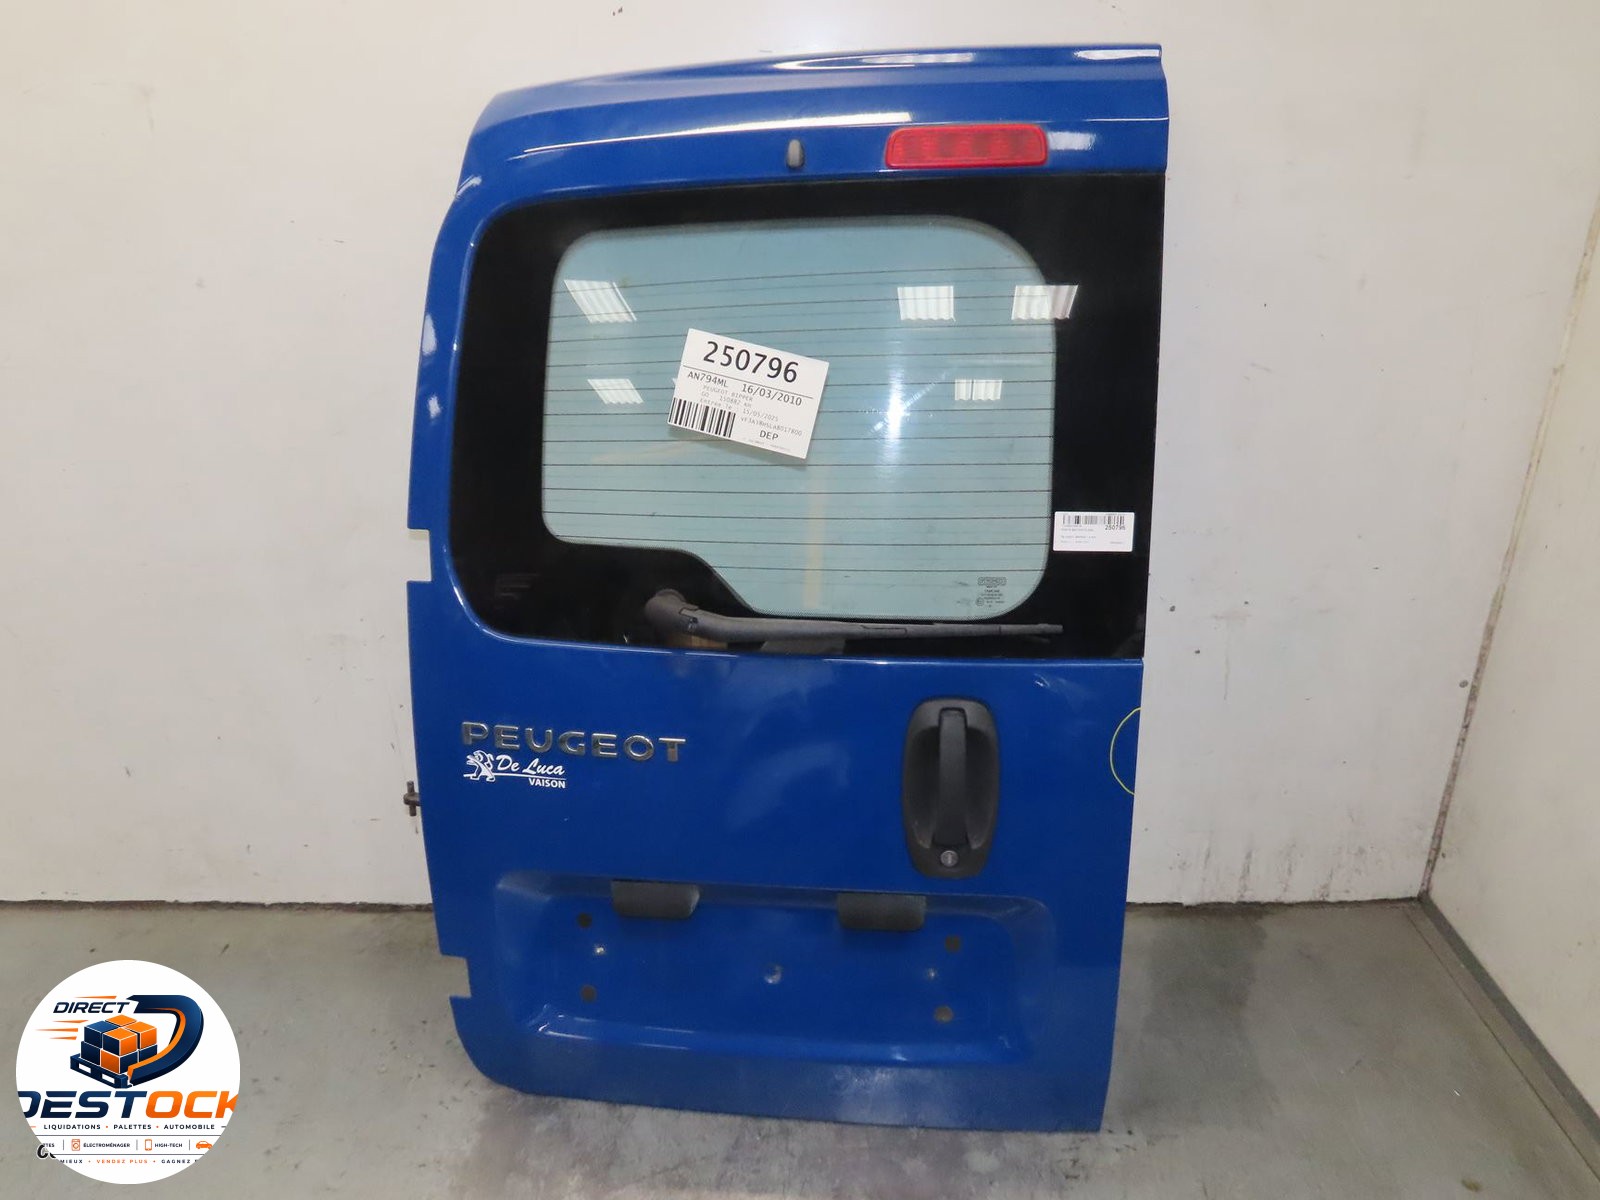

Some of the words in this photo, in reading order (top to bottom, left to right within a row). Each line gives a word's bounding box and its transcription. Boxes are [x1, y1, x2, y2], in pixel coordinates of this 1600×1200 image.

[703, 341, 799, 383] 250796
[687, 371, 728, 387] AN794ML
[742, 383, 802, 407] 16/03/2010
[759, 430, 779, 440] DEP
[461, 721, 687, 762] PEUGEOT
[496, 754, 520, 772] De
[522, 758, 566, 776] Luca
[528, 777, 566, 789] VAISON
